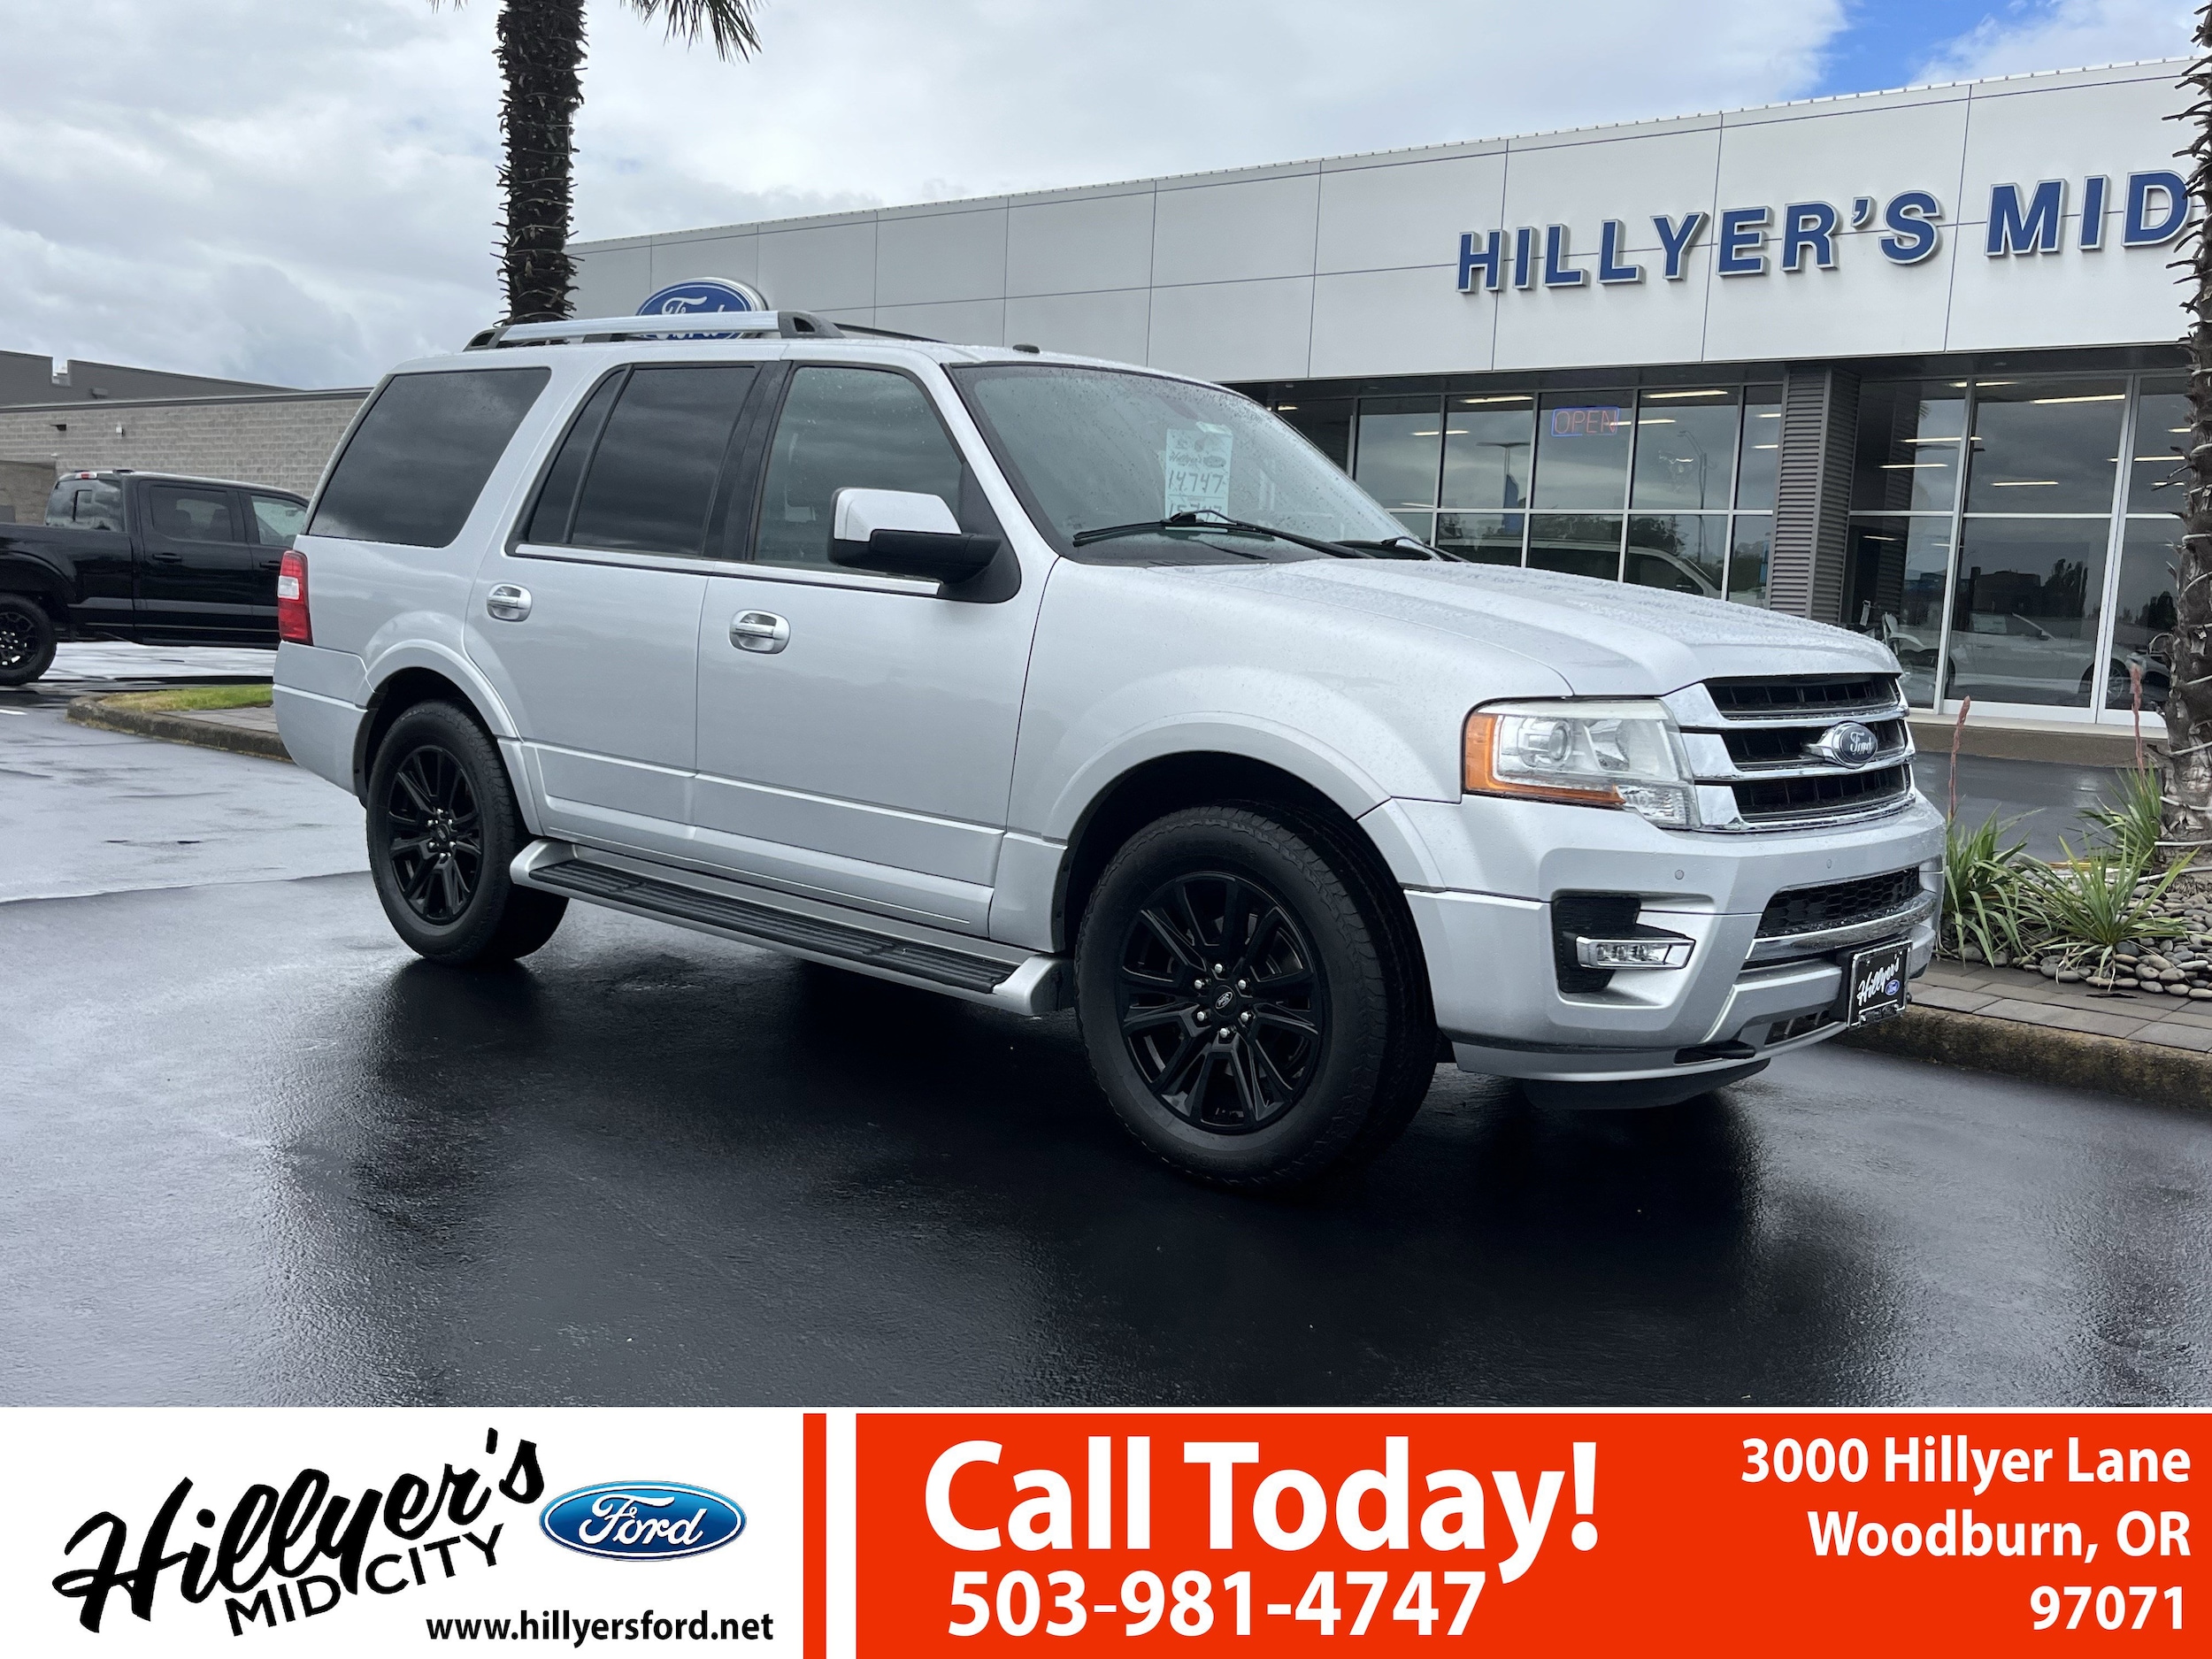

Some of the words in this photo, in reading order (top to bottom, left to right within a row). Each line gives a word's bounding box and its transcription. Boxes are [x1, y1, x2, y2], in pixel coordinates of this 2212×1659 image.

[1455, 189, 1943, 294] HILLYER'S
[1984, 170, 2192, 257] MID
[1555, 410, 1617, 434] OPEN
[1168, 469, 1225, 494] 14747
[1849, 731, 1873, 756] Ford
